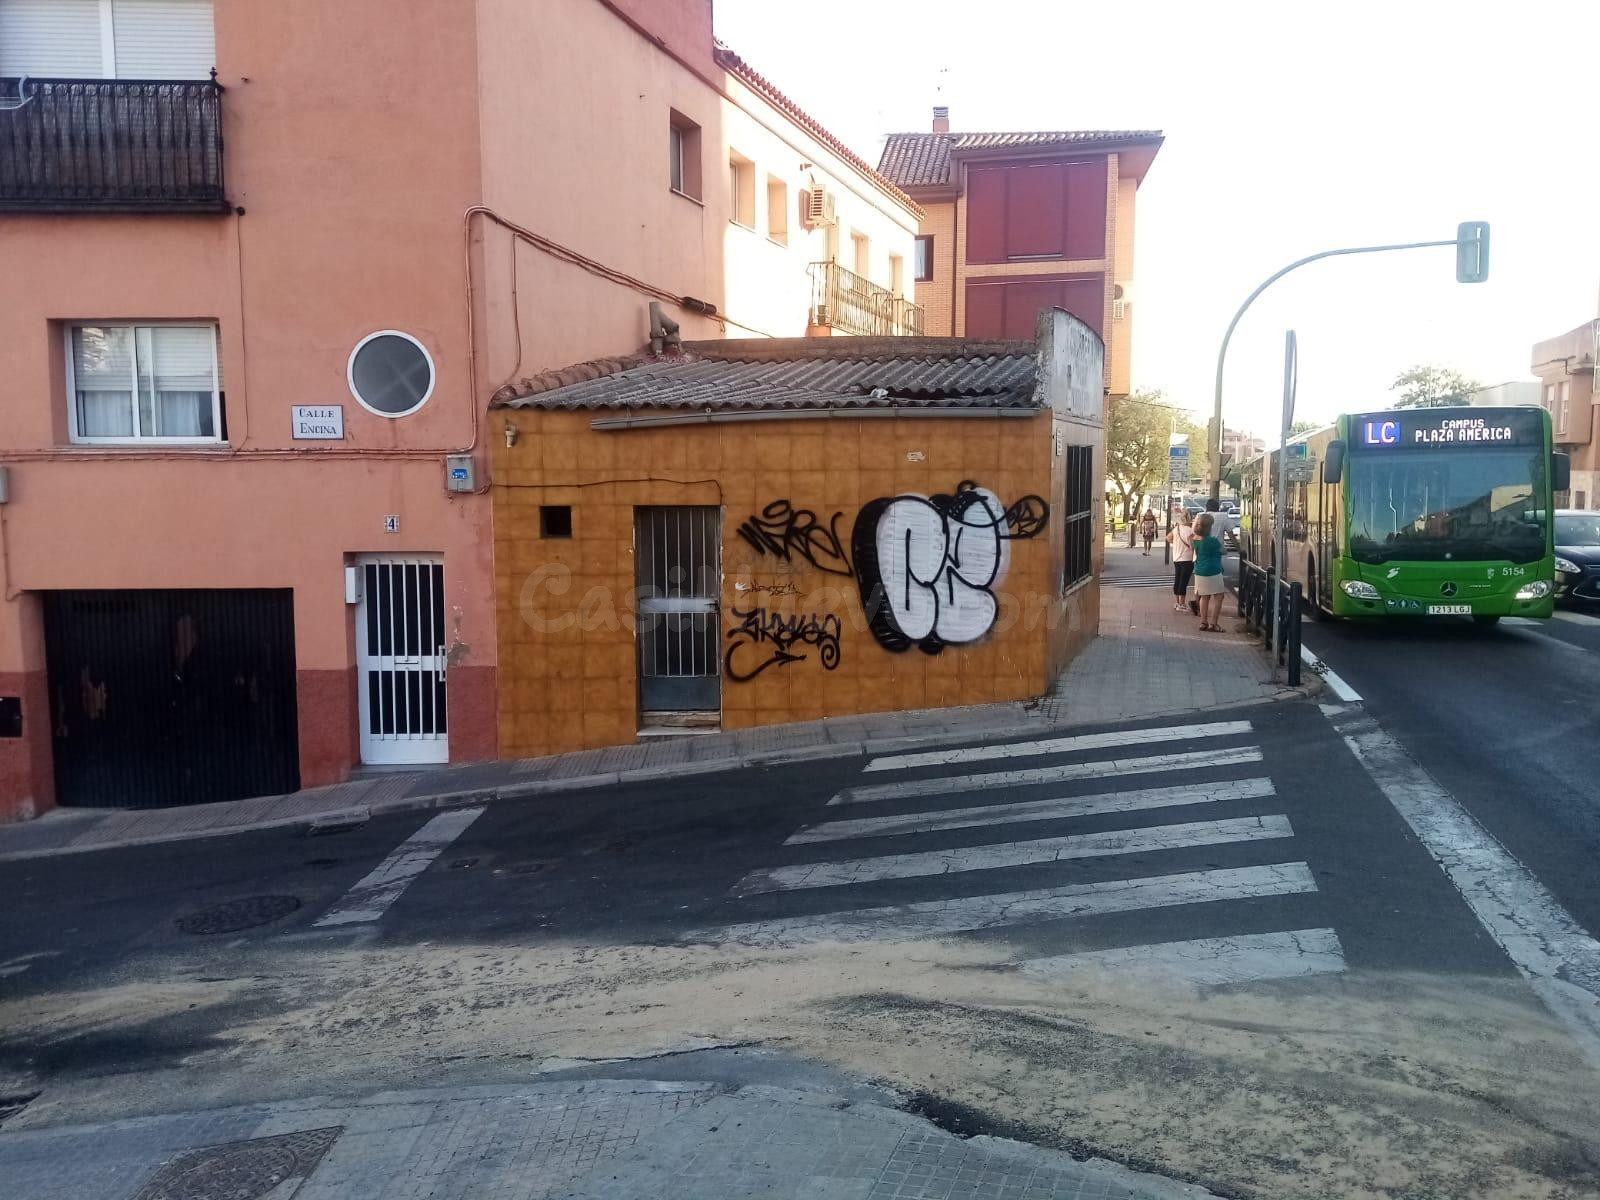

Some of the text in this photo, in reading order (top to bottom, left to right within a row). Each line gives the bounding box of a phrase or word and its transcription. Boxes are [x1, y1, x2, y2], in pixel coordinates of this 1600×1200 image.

[299, 408, 335, 418] CALLE
[300, 422, 337, 434] ENCINA
[1442, 419, 1485, 429] CAMPUS
[1367, 421, 1395, 444] LC
[1415, 429, 1454, 443] PLAZA
[388, 518, 395, 530] 4
[1502, 567, 1525, 576] 5154
